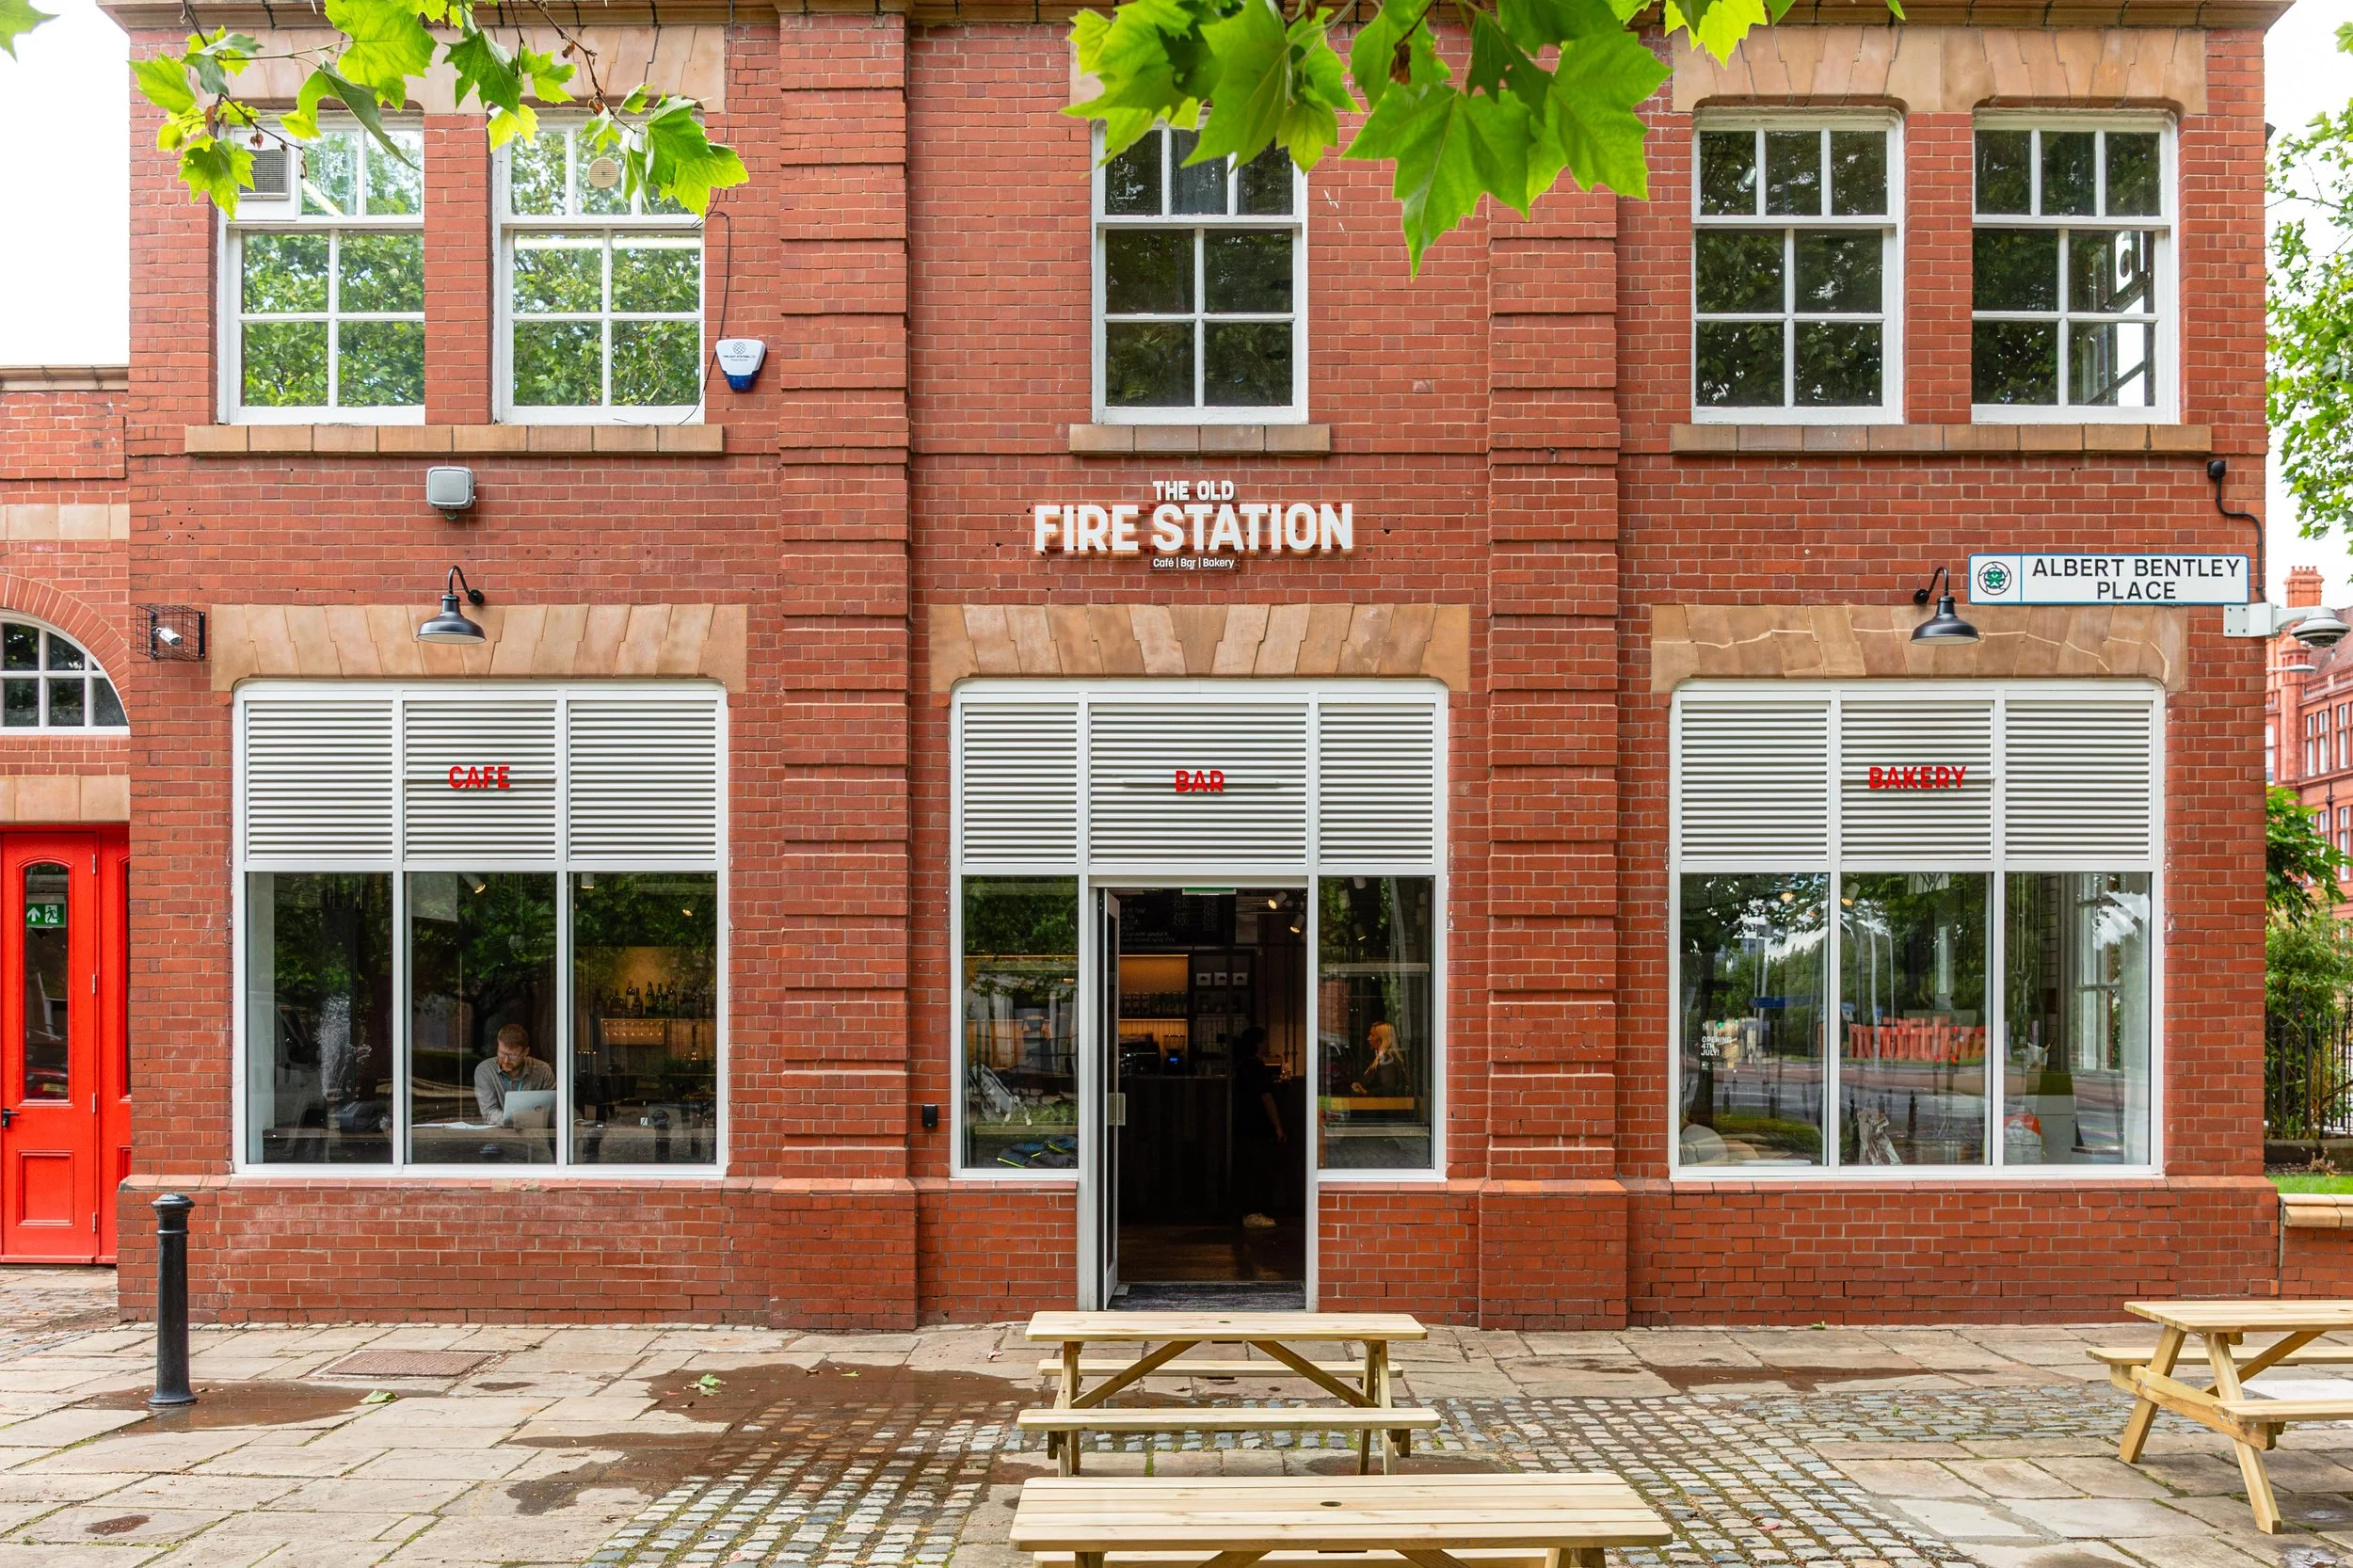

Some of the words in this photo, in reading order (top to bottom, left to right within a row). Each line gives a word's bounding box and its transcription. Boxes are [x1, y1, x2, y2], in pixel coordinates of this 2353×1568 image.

[1152, 480, 1189, 501] THE
[1196, 480, 1235, 501] OLD
[1034, 504, 1139, 552] FIRE
[1152, 503, 1353, 552] STATION
[1153, 557, 1175, 568] Café
[1180, 557, 1196, 568] Bar
[1203, 557, 1235, 569] Bakery
[2031, 557, 2125, 578] ALBERT
[2134, 557, 2240, 578] BENTLEY
[2096, 581, 2177, 600] PLACE
[1175, 770, 1225, 792] BAR
[1867, 766, 1967, 790] BAKERY
[1702, 1035, 1732, 1044] OPENING
